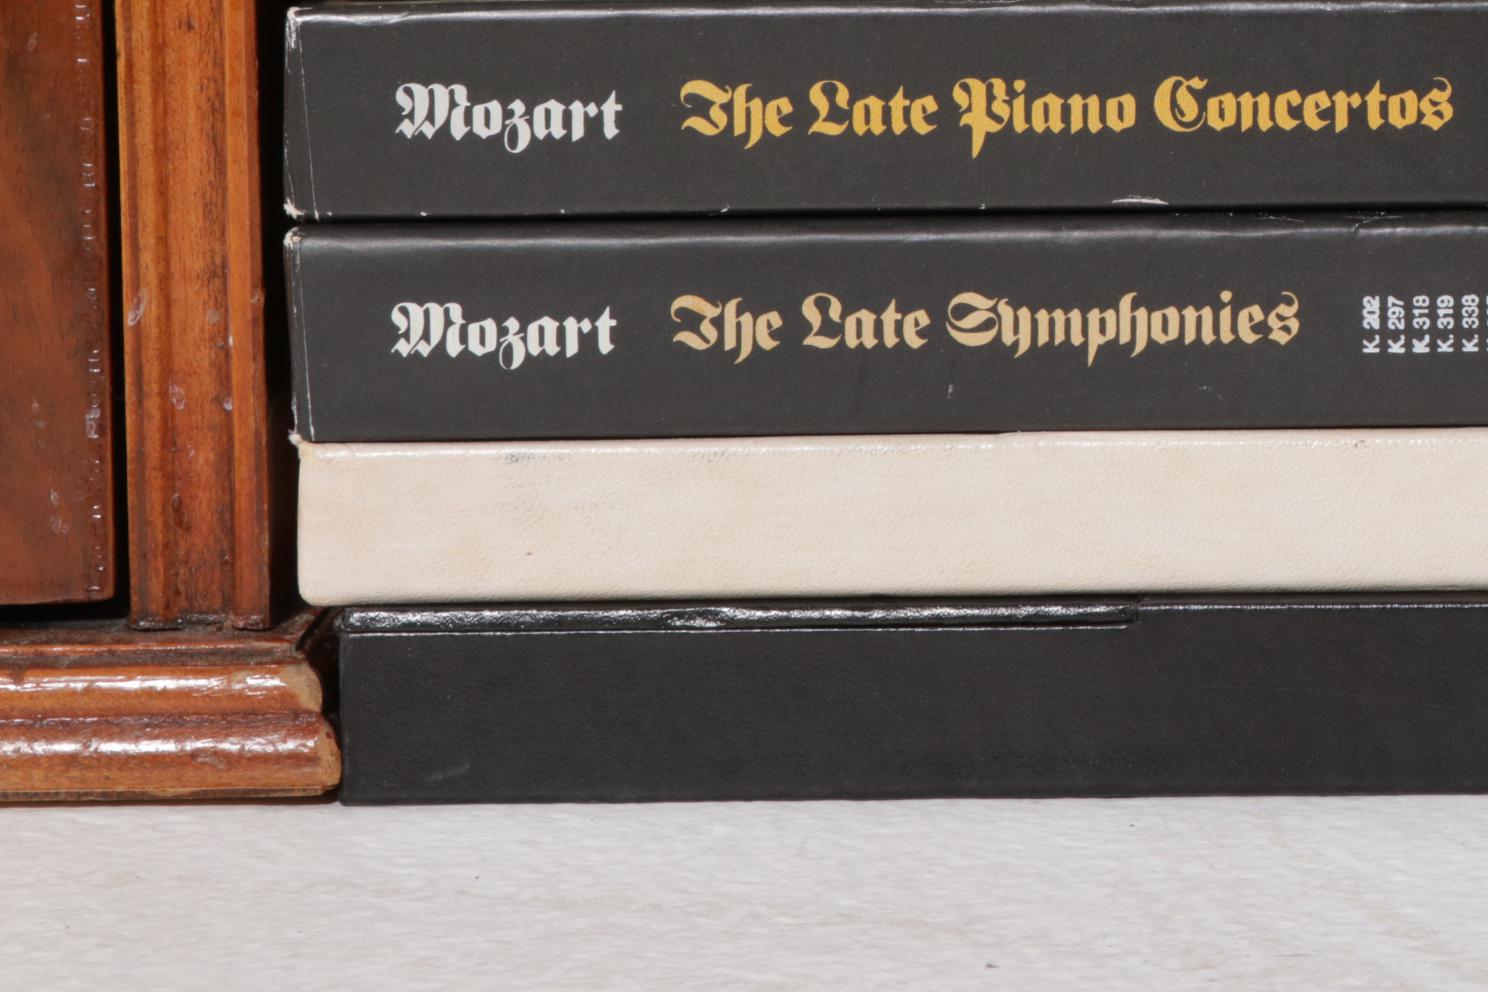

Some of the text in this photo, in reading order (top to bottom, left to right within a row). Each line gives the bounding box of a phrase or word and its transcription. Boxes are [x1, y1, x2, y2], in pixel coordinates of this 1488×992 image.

[395, 74, 1456, 160] Mozart The Late Piano Concertos
[391, 287, 1301, 371] Mozart The Late Symphonies
